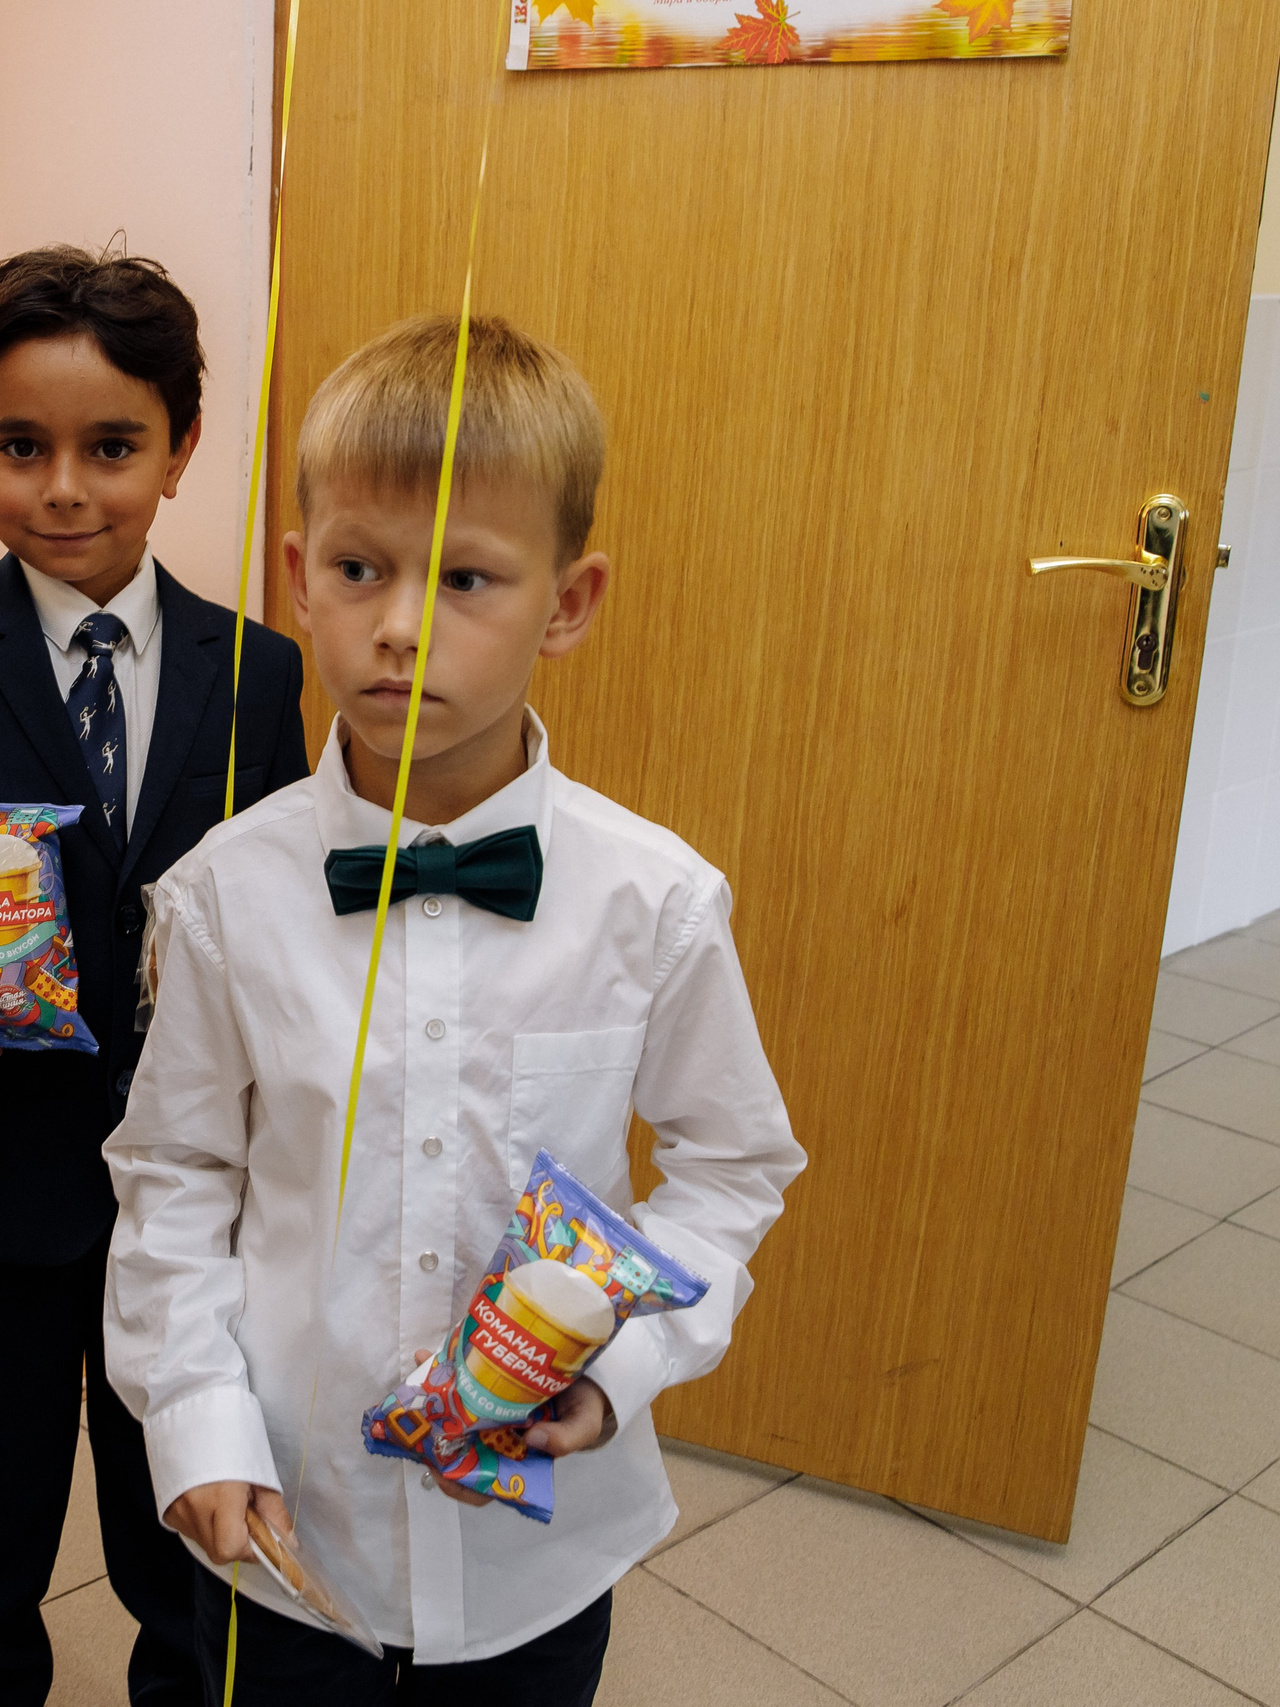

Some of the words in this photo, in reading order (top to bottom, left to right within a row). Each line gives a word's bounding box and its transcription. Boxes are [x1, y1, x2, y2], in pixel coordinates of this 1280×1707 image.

[7, 933, 39, 957] ВКУСОМ
[475, 1300, 547, 1365] КОМАНДА
[478, 1397, 494, 1410] СО
